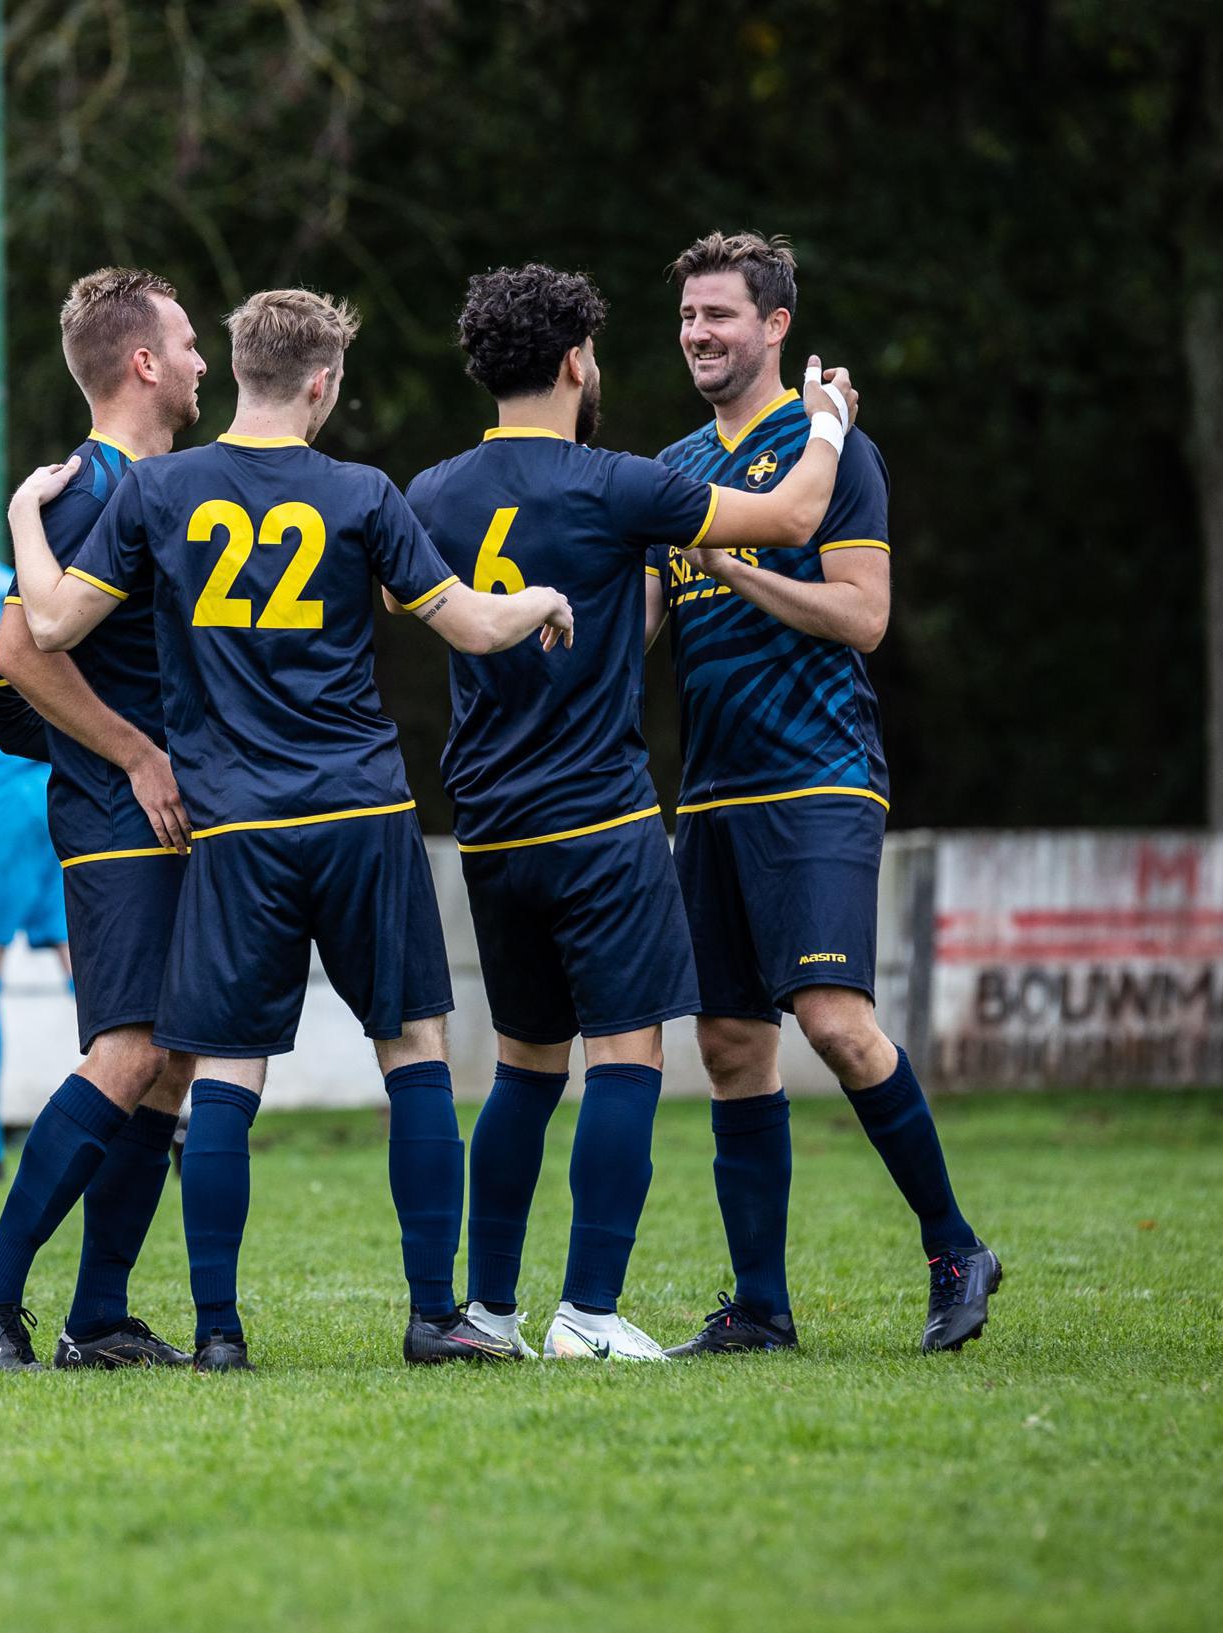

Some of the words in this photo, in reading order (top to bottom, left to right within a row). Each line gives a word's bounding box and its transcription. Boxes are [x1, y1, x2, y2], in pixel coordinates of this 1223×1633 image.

[187, 500, 326, 629] 22
[473, 507, 526, 595] 6
[978, 966, 1223, 1024] BOUWM
